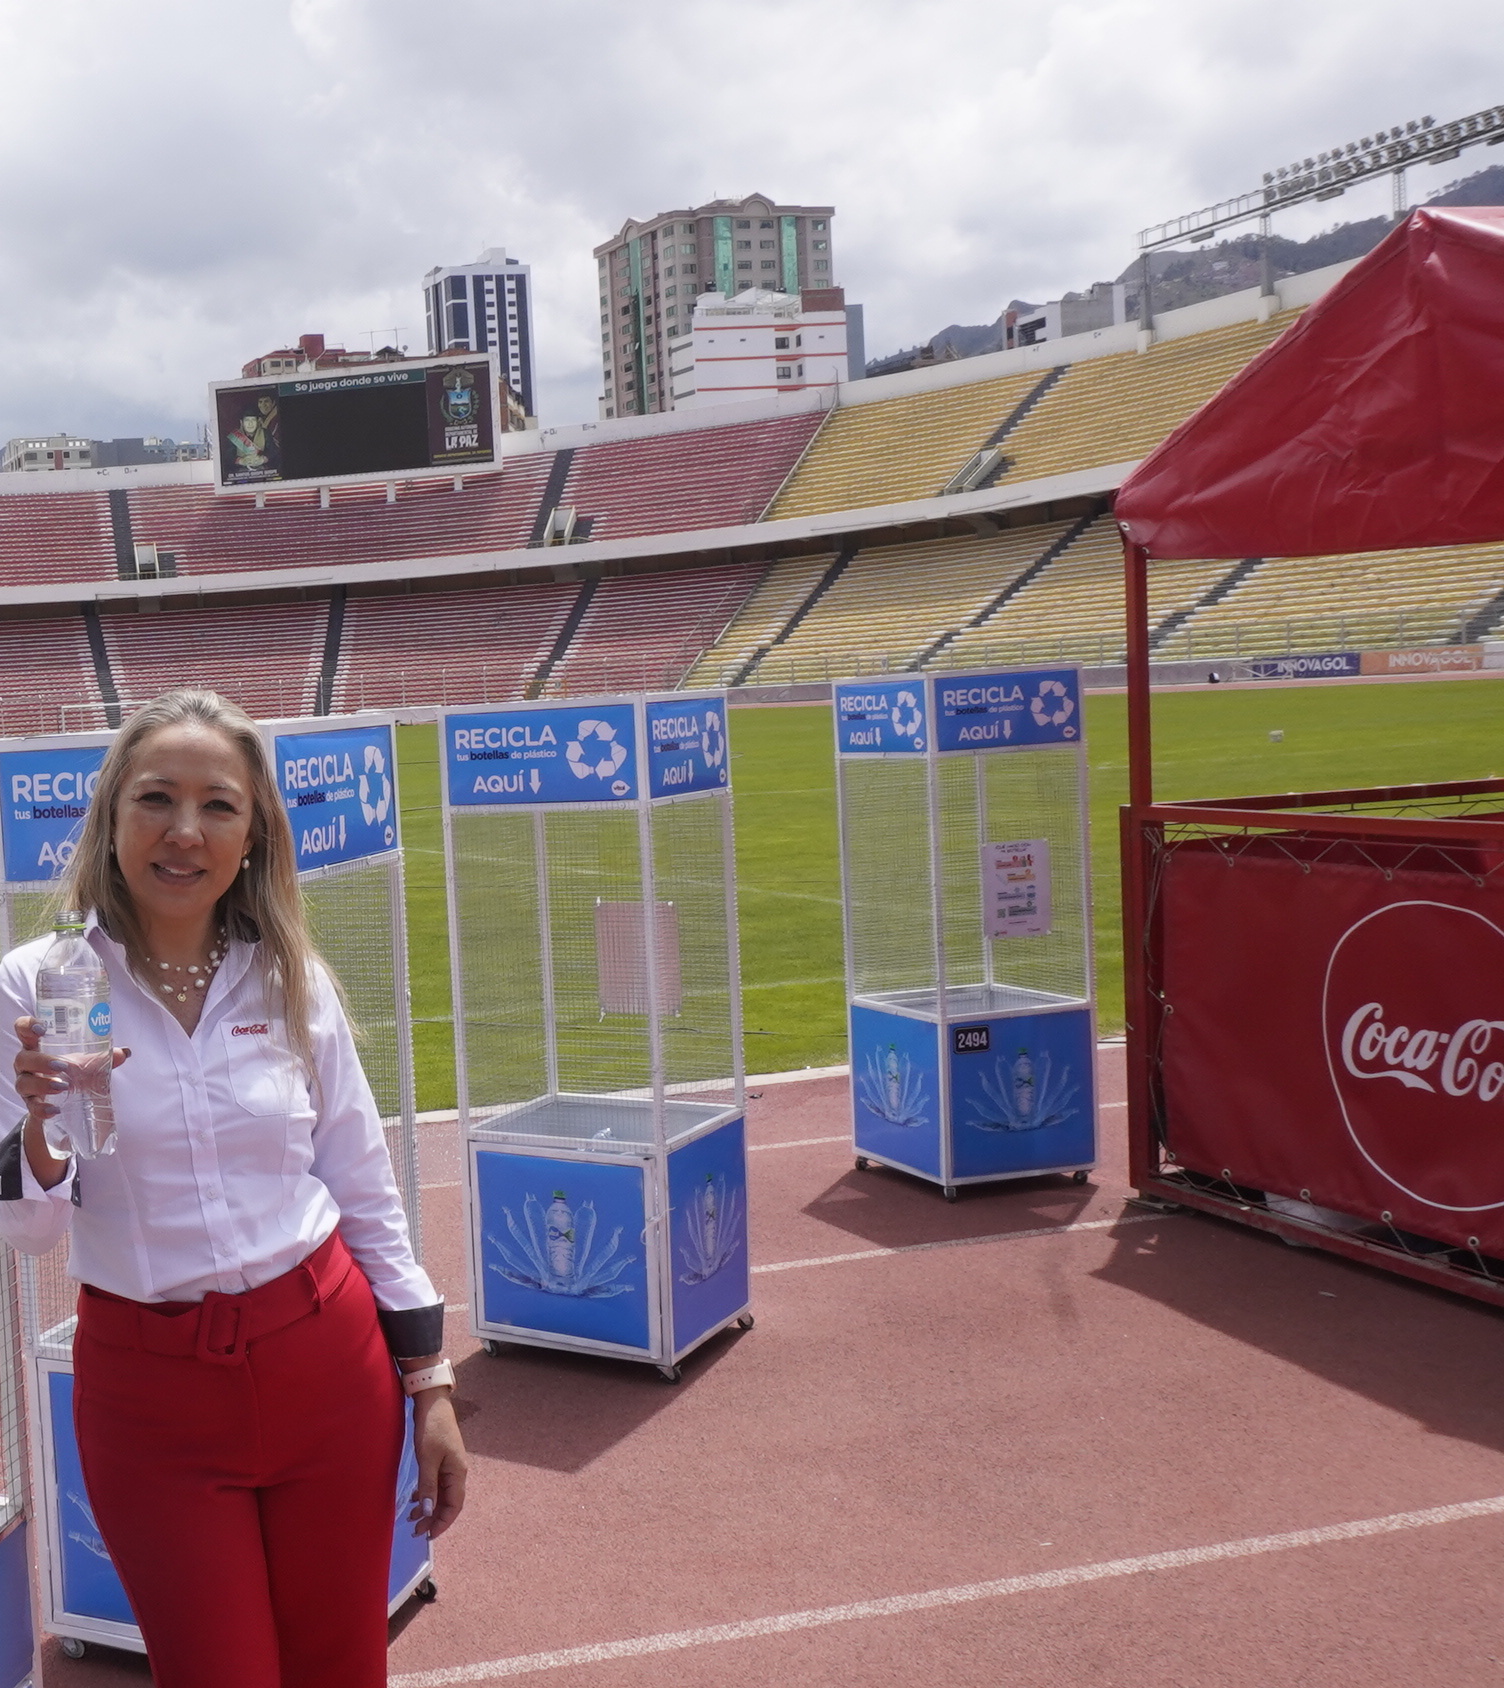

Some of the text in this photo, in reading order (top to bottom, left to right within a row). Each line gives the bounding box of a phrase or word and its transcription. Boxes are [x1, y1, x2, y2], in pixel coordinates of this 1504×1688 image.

[294, 372, 409, 393] Se juega donde se vive
[840, 694, 889, 712] RECICLA
[942, 685, 1025, 707] RECICLA
[454, 725, 558, 750] RECICLA
[652, 716, 699, 740] RECICLA
[849, 727, 874, 745] AQUÍ
[958, 720, 999, 741] AQUÍ
[456, 748, 558, 762] tus botellas de plástico
[284, 752, 355, 791] RECICLA
[473, 769, 525, 793] AQUÍ
[662, 760, 687, 786] AQUÍ
[297, 790, 326, 807] botellas
[14, 804, 87, 820] tus botellas
[300, 816, 337, 856] AQUÍ
[957, 1031, 988, 1049] 2494
